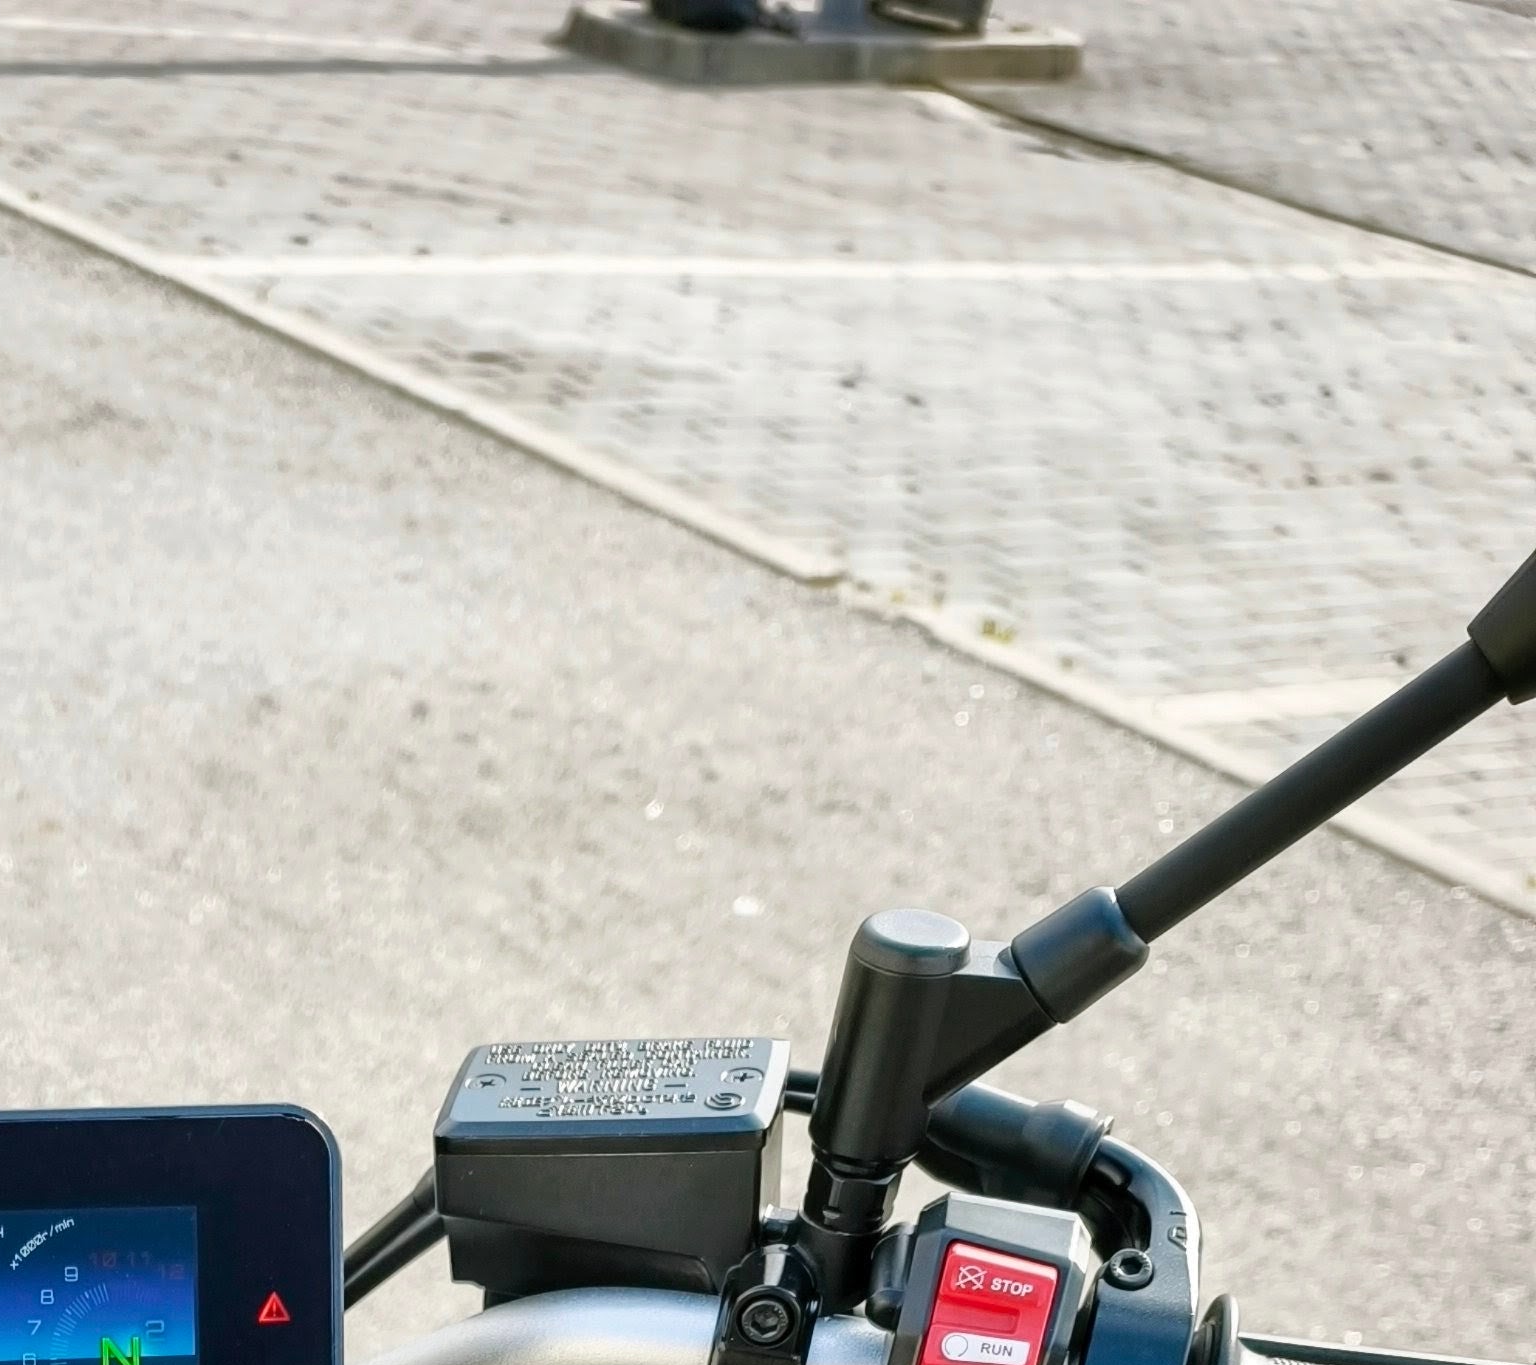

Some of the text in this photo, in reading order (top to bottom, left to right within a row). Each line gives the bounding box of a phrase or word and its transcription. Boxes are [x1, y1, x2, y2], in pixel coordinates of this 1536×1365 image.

[557, 1078, 657, 1094] WARNING
[64, 1266, 79, 1282] 9
[990, 1276, 1034, 1297] STOP
[40, 1289, 54, 1305] 8
[27, 1320, 42, 1335] 7
[980, 1342, 1013, 1358] RUN
